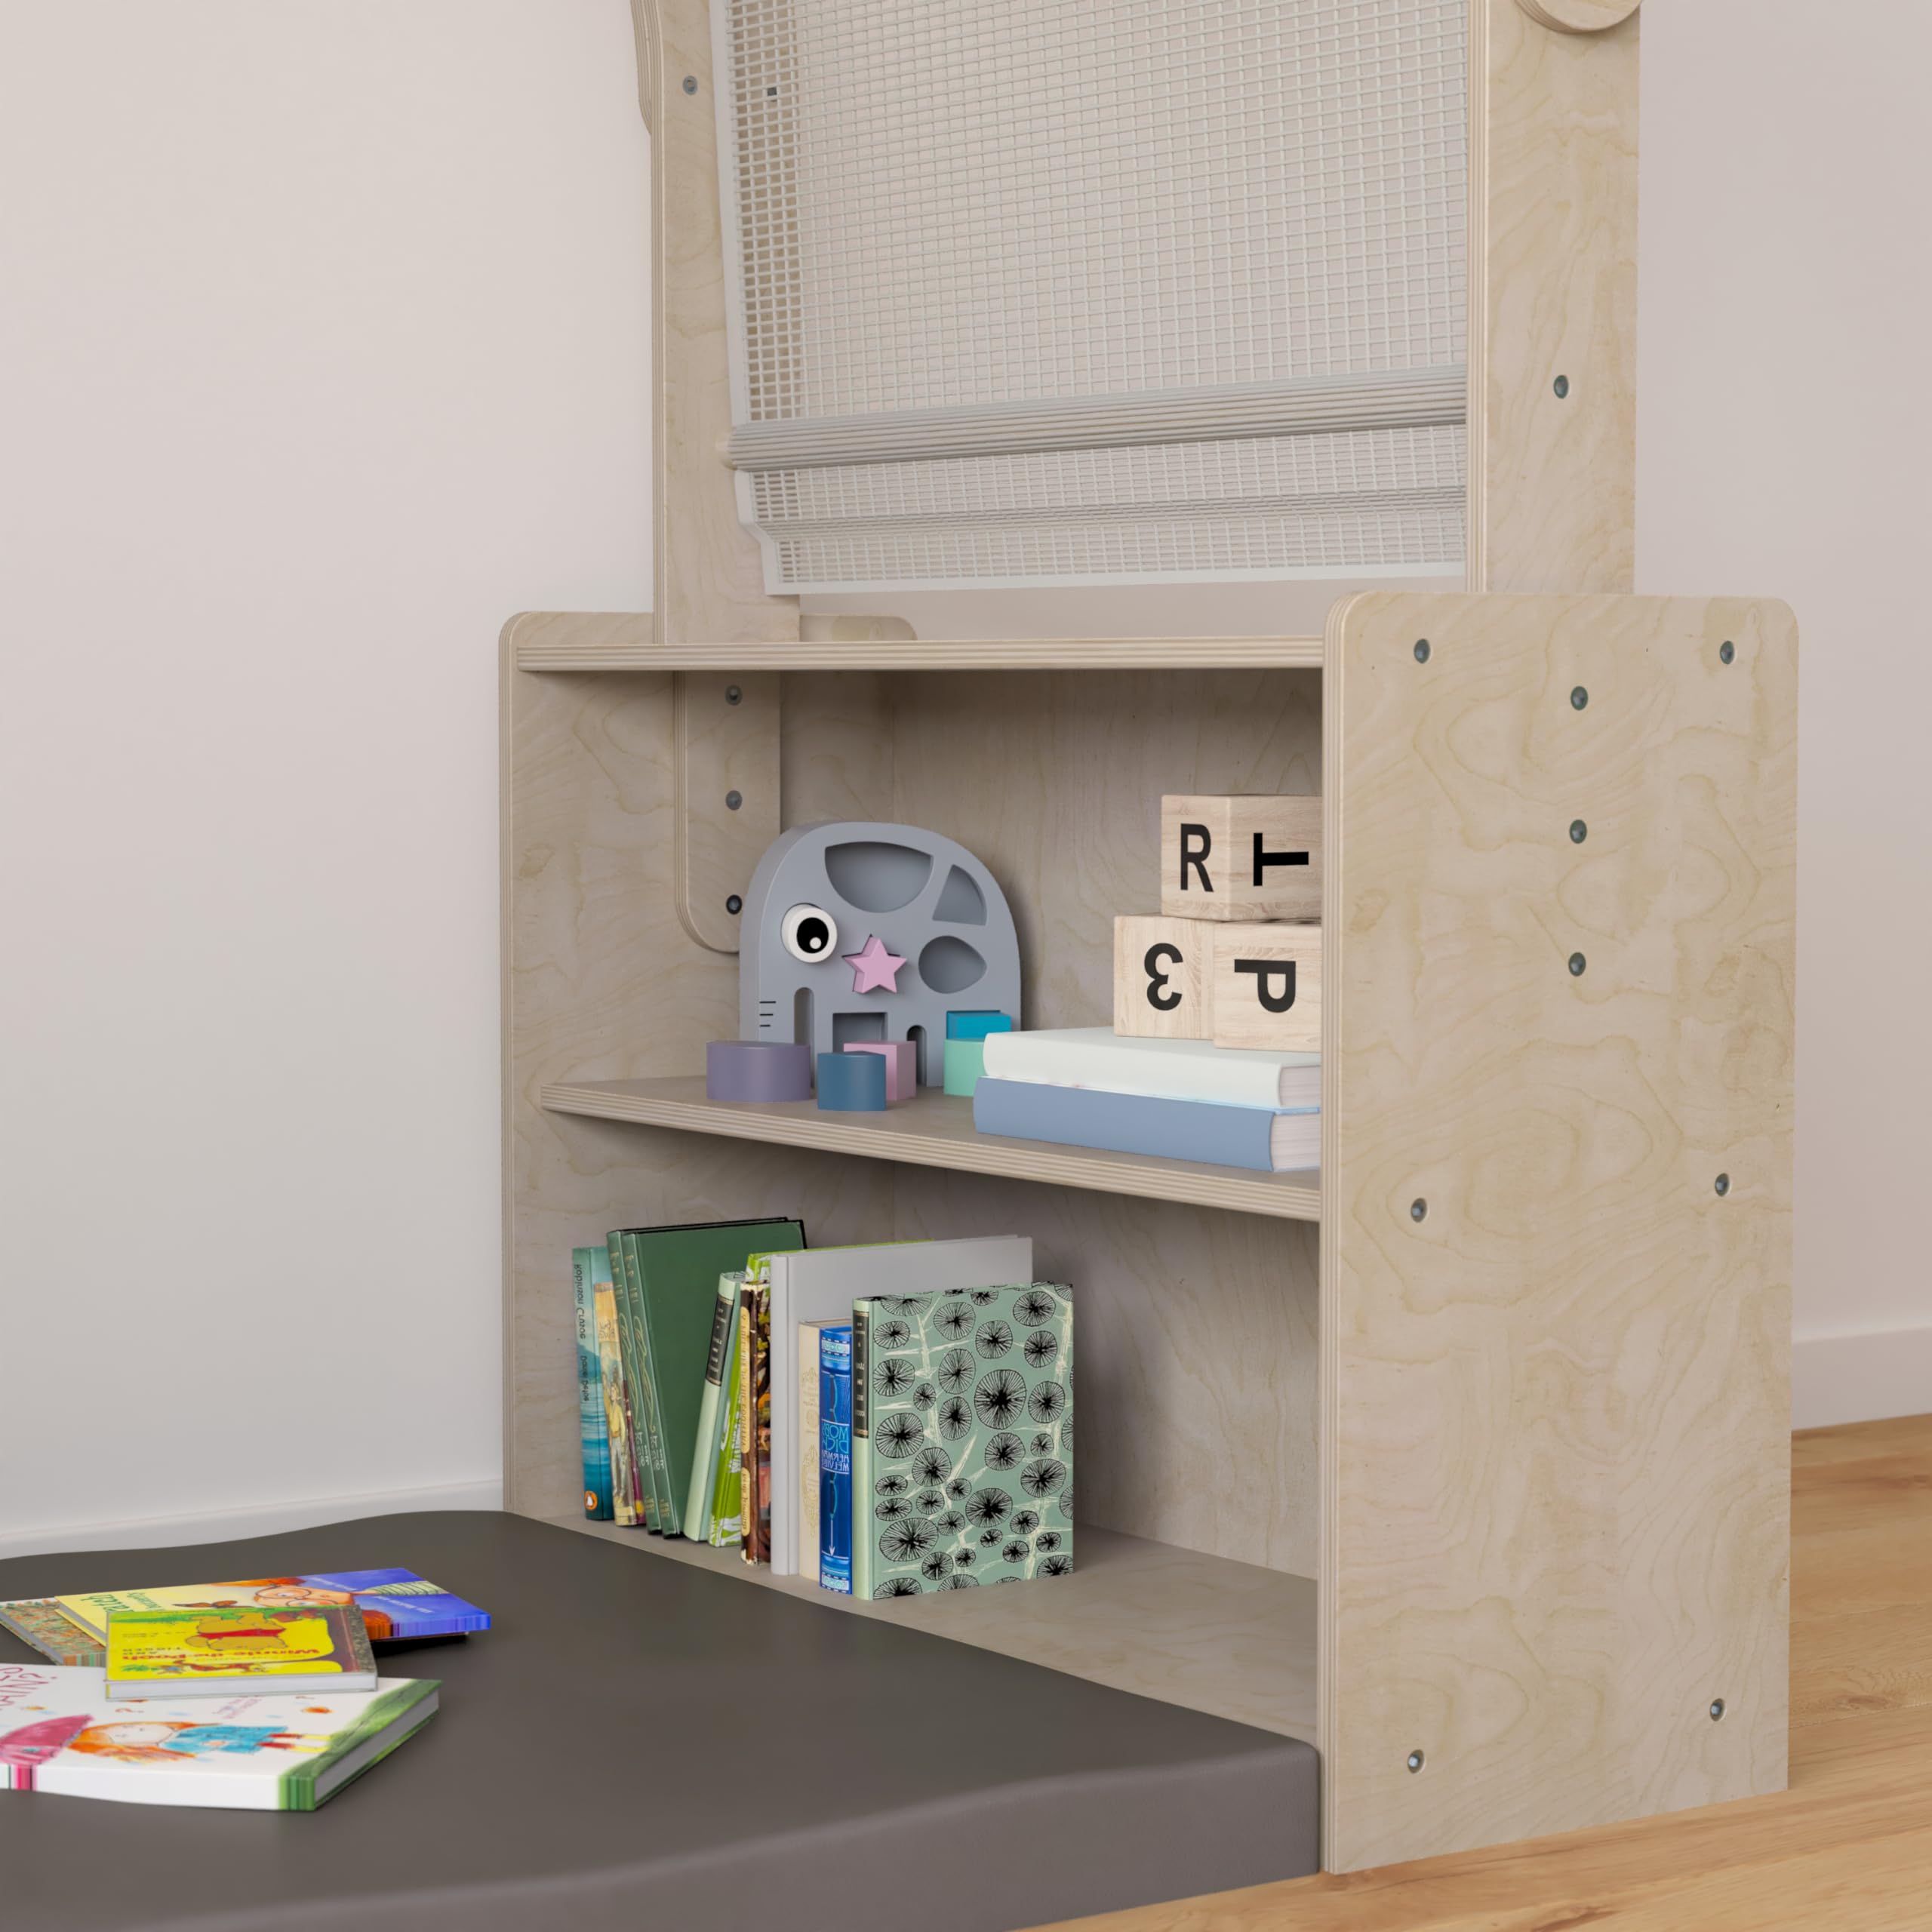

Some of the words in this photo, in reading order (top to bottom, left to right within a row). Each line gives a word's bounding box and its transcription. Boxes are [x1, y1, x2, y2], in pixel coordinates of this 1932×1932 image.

[1180, 823, 1214, 892] R
[1253, 832, 1309, 887] T
[1143, 942, 1184, 1011] 3
[1234, 958, 1297, 1014] P
